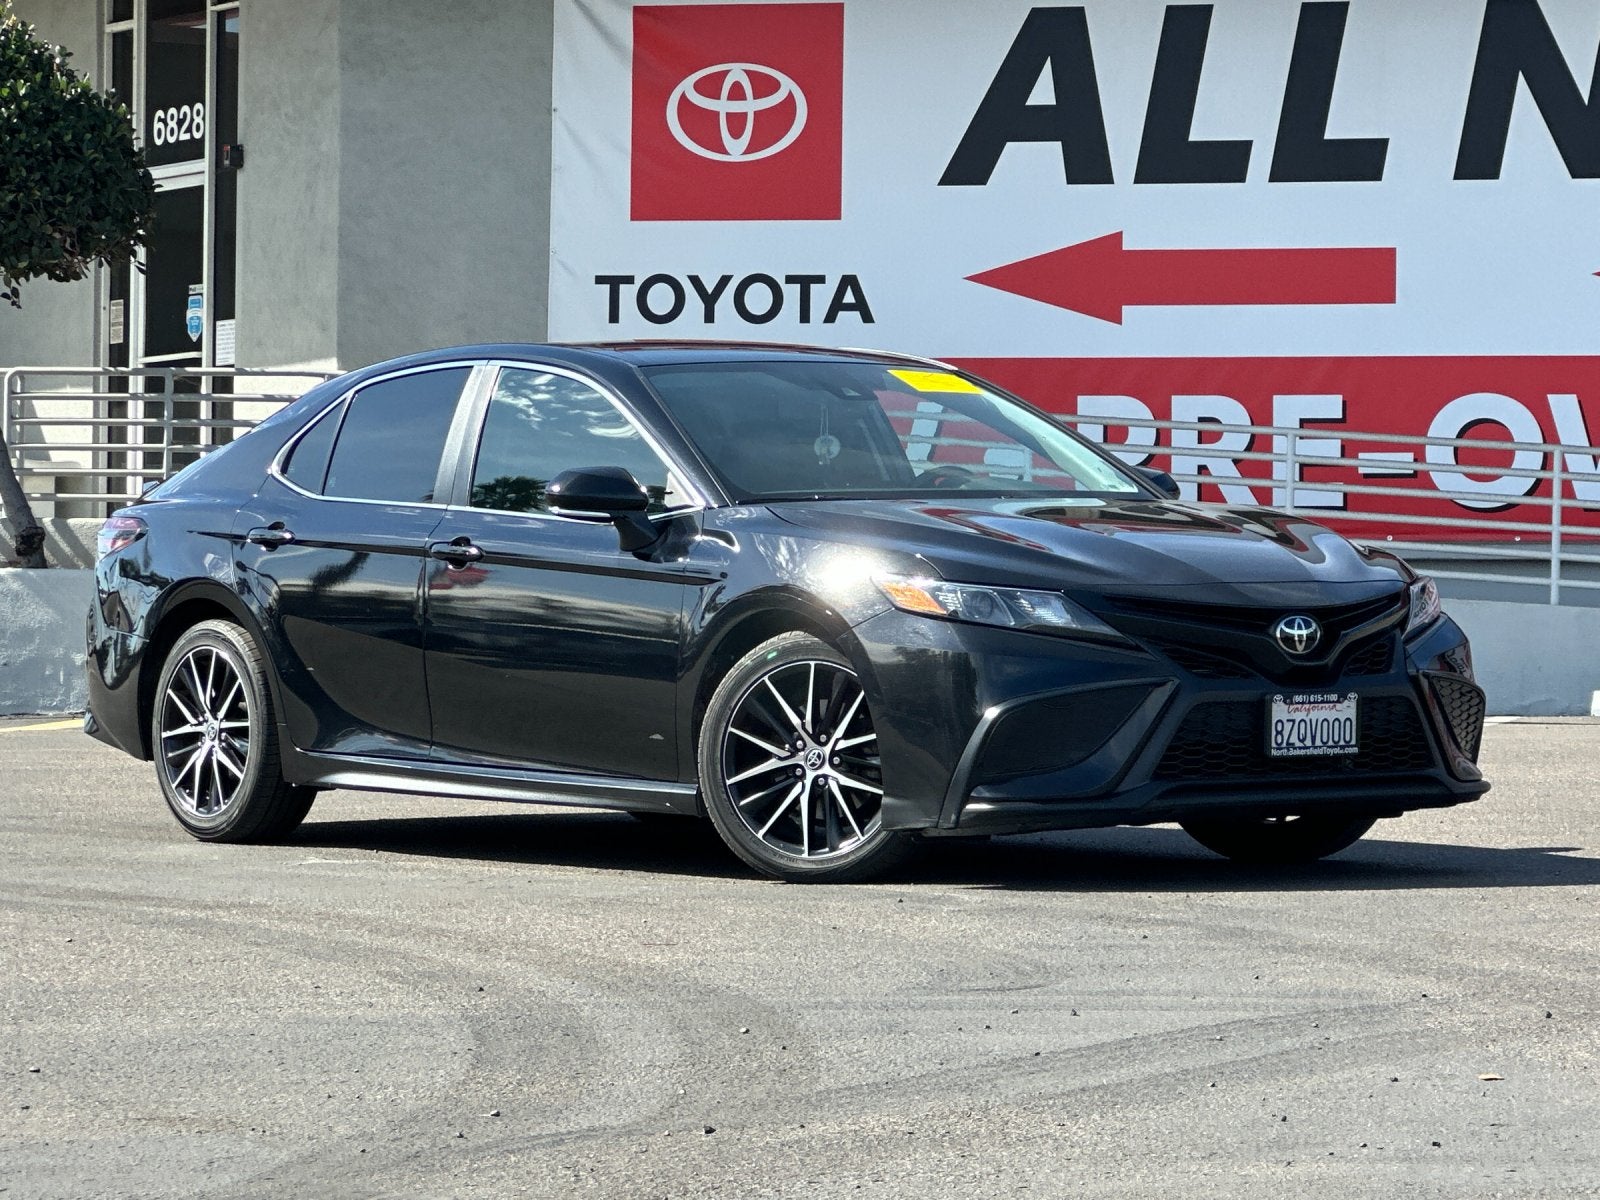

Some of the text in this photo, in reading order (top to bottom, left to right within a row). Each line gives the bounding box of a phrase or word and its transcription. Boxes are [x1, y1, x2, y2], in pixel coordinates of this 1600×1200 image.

[937, 2, 1390, 186] ALL
[153, 102, 204, 146] 6828
[595, 273, 876, 325] TOYOTA
[1287, 703, 1343, 716] California
[1292, 693, 1338, 703] (661) 615-1100
[1274, 717, 1353, 747] 8ZQV000
